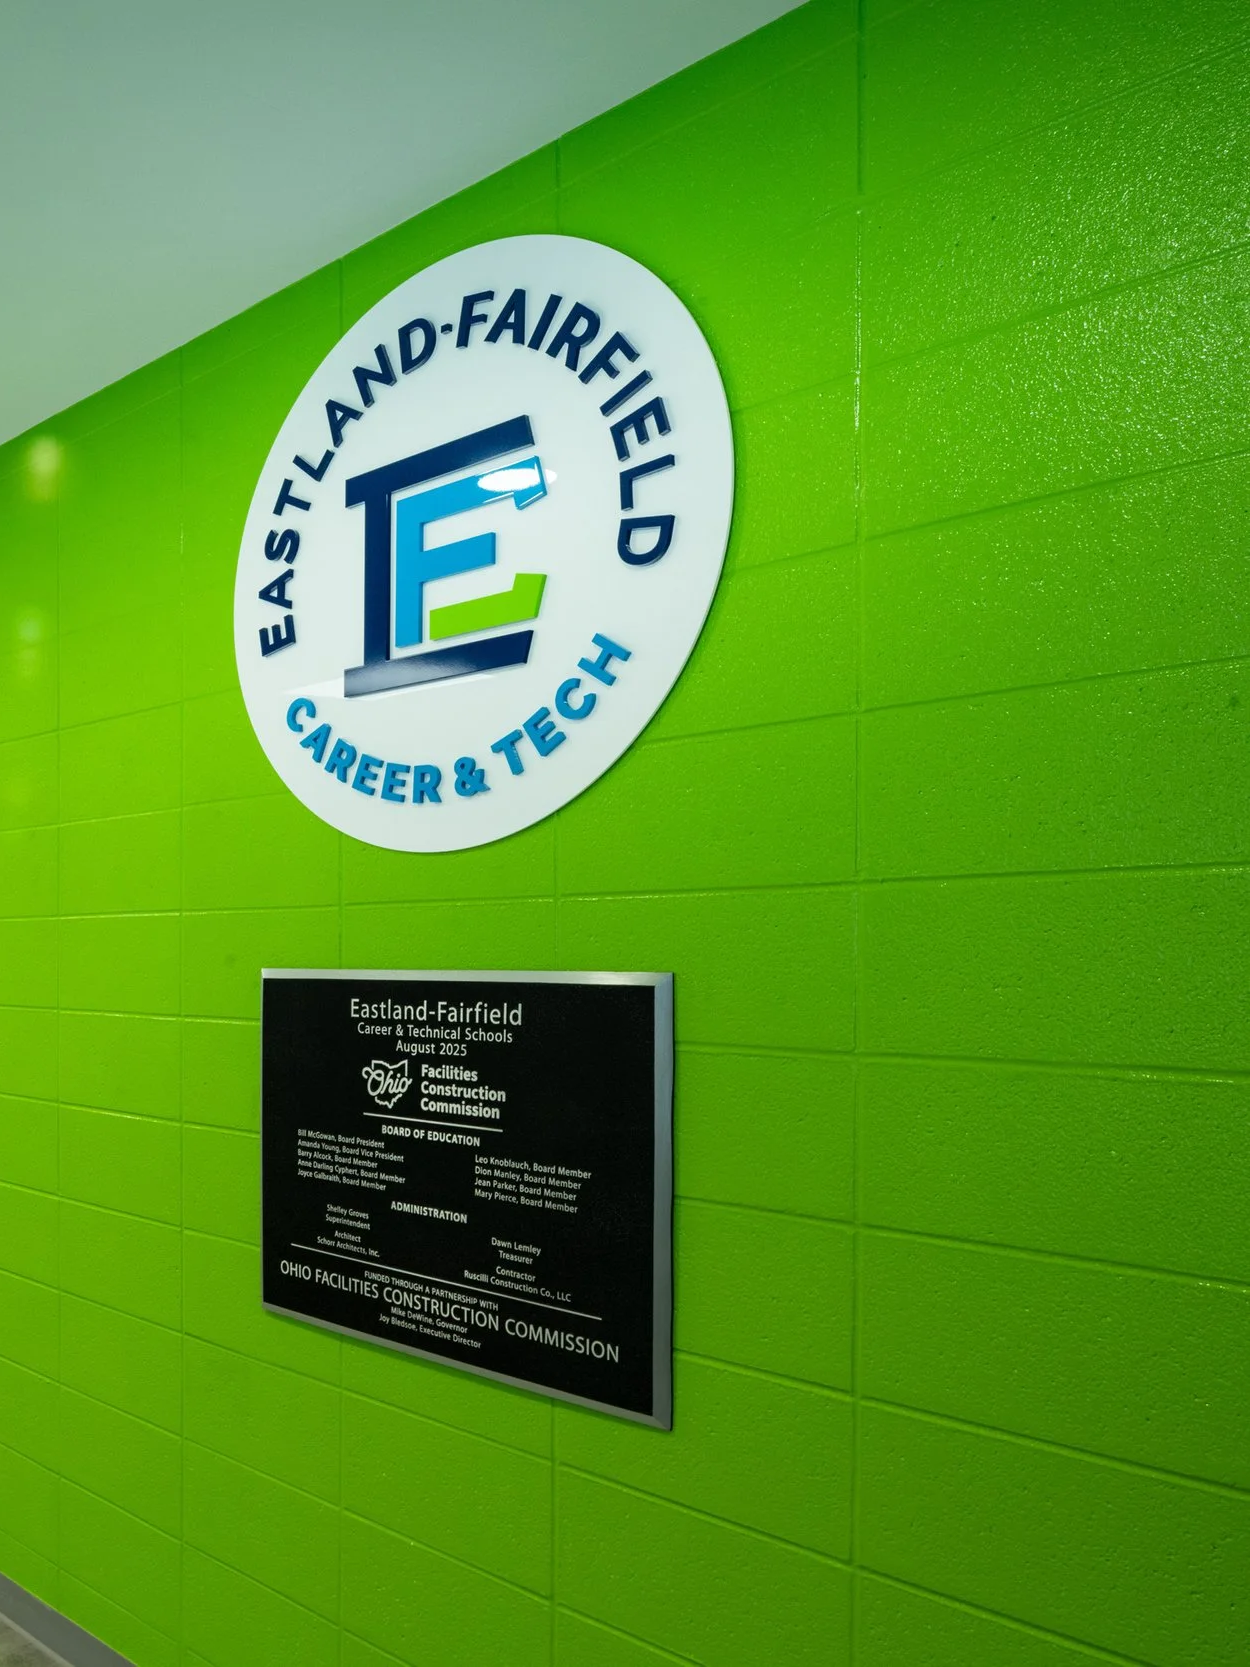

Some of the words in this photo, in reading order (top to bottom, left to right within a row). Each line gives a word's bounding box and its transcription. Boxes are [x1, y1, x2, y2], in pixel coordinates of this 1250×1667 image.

[258, 289, 675, 658] EASTLAND-FAIRFIELD
[286, 697, 442, 804] CAREER
[453, 757, 490, 798] &
[491, 633, 632, 776] TECH
[351, 998, 522, 1025] Eastland-Fairfield
[357, 1022, 392, 1036] Career
[396, 1024, 404, 1036] &
[407, 1025, 461, 1040] Technical
[465, 1028, 512, 1043] Schools
[396, 1040, 435, 1055] August
[440, 1043, 467, 1056] 2025
[362, 1067, 412, 1096] Ohio
[421, 1064, 478, 1081] Facilities
[421, 1081, 506, 1102] Construction
[421, 1098, 500, 1119] Commission
[298, 1129, 306, 1137] Bill
[308, 1130, 336, 1142] McGowan,
[338, 1135, 355, 1144] Board
[356, 1137, 385, 1148] President
[381, 1124, 410, 1139] BOARD
[413, 1128, 425, 1140] OF
[427, 1130, 480, 1147] EDUCATION
[298, 1139, 320, 1149] Amanda
[322, 1142, 341, 1153] Young,
[342, 1145, 359, 1155] Board
[361, 1149, 373, 1157] Vice
[375, 1151, 404, 1162] President
[298, 1149, 312, 1158] Barry
[313, 1151, 333, 1161] Alcock,
[335, 1155, 351, 1164] Board
[353, 1159, 378, 1168] Member
[298, 1159, 312, 1168] Anne
[313, 1161, 333, 1172] Darling
[335, 1165, 359, 1176] Cyphert,
[360, 1169, 378, 1179] Board
[380, 1172, 405, 1183] Member
[475, 1155, 488, 1164] Leo
[490, 1157, 531, 1171] Knoblauch,
[533, 1163, 555, 1174] Board
[558, 1166, 591, 1179] Member
[475, 1166, 492, 1176] Dion
[494, 1169, 522, 1182] Manley,
[524, 1174, 546, 1184] Board
[548, 1177, 581, 1190] Member
[298, 1169, 312, 1178] Joyce
[314, 1171, 341, 1183] Galbraith,
[343, 1176, 359, 1186] Board
[361, 1180, 386, 1190] Member
[475, 1178, 490, 1187] Jean
[493, 1180, 517, 1192] Parker,
[520, 1184, 541, 1195] Board
[544, 1188, 576, 1201] Member
[327, 1204, 347, 1216] Shelley
[349, 1208, 369, 1219] Groves
[391, 1201, 467, 1224] ADMINISTRATION
[475, 1189, 492, 1200] Mary
[494, 1192, 518, 1204] Pierce,
[521, 1196, 542, 1207] Board
[545, 1201, 578, 1213] Member
[326, 1214, 370, 1230] Superintendent
[317, 1236, 335, 1247] Schorr
[337, 1241, 367, 1255] Architects,
[369, 1248, 380, 1257] Inc.
[334, 1231, 361, 1243] Architect
[491, 1237, 512, 1249] Dawn
[514, 1242, 541, 1256] Lemley
[499, 1250, 533, 1264] Treasurer
[496, 1266, 536, 1282] Contractor
[364, 1271, 390, 1284] FUNDED
[391, 1277, 423, 1292] THROUGH
[425, 1285, 430, 1293] A
[431, 1287, 478, 1304] PARTNERSHIP
[479, 1300, 499, 1311] WITH
[464, 1270, 488, 1283] Ruscilli
[490, 1276, 538, 1294] Construction
[540, 1288, 555, 1299] Co.,
[557, 1291, 571, 1302] LLC
[280, 1260, 312, 1281] OHIO
[315, 1268, 379, 1299] FACILITIES
[383, 1287, 499, 1332] CONSTRUCTION
[505, 1318, 620, 1363] COMMISSION
[391, 1307, 406, 1317] Mike
[407, 1311, 434, 1324] DeWine,
[436, 1318, 468, 1334] Governor
[379, 1313, 390, 1325] Joy
[391, 1317, 417, 1331] Bledsoe,
[419, 1324, 451, 1340] Executive
[453, 1334, 482, 1349] Director
